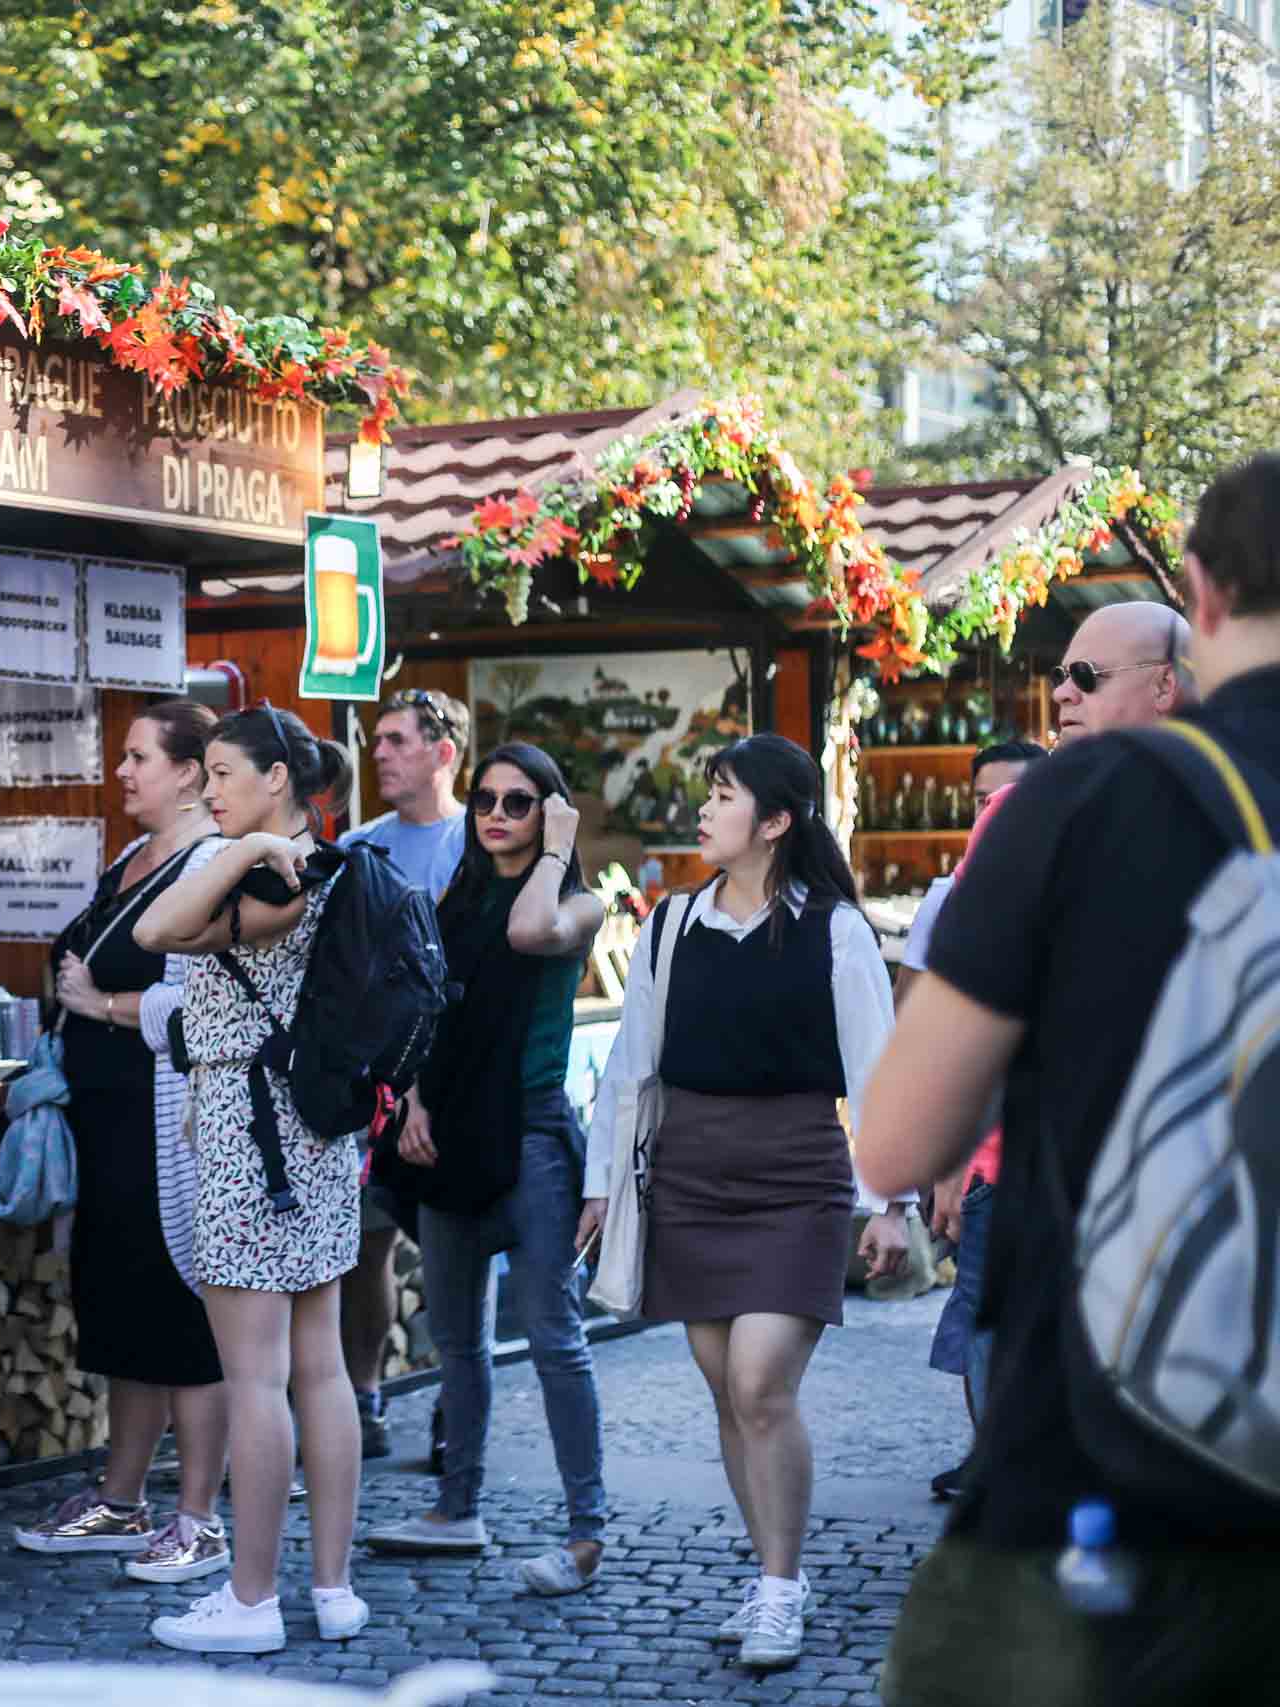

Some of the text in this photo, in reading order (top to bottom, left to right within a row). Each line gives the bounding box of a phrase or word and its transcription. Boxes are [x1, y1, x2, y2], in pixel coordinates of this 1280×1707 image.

[163, 455, 285, 526] DI PRAGA
[105, 628, 163, 649] SAUSAGE
